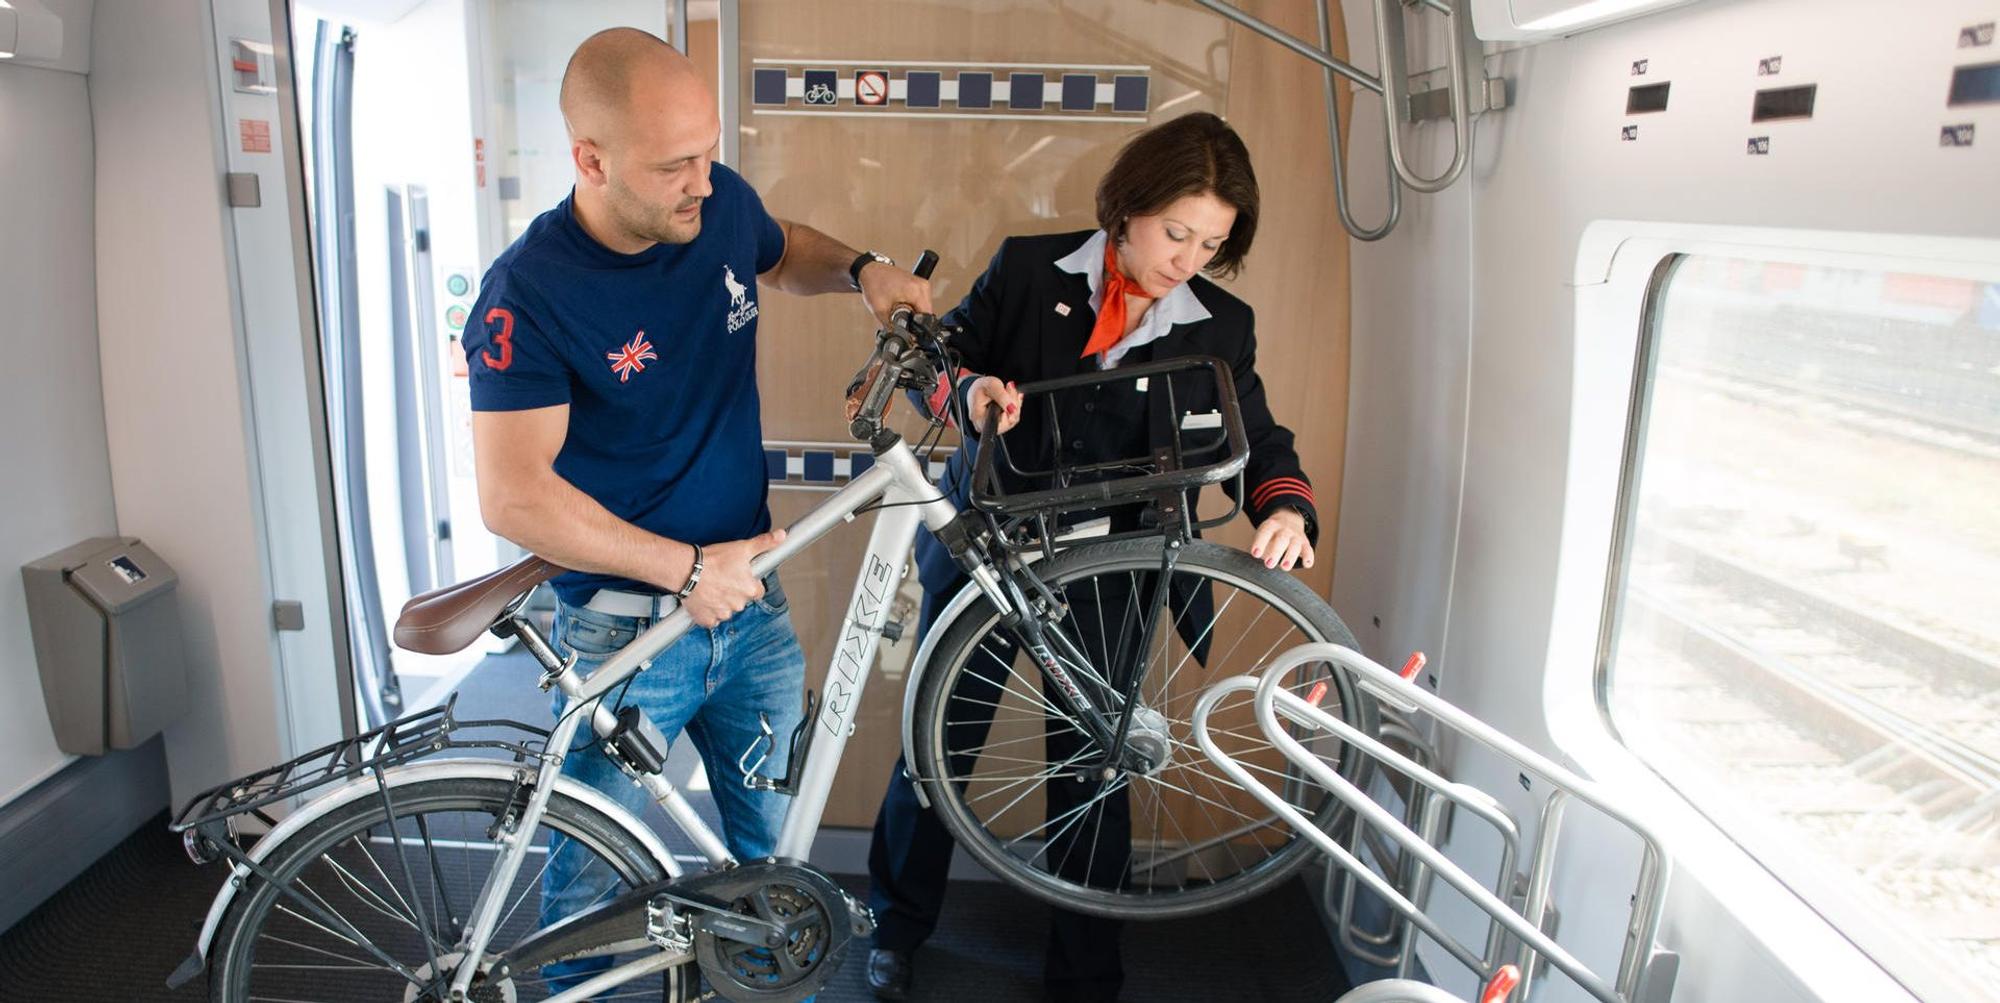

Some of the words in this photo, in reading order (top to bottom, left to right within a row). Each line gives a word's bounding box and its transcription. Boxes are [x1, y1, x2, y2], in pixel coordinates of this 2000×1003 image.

[482, 307, 514, 371] 3
[727, 315, 746, 334] POLO
[821, 554, 893, 736] RIXE
